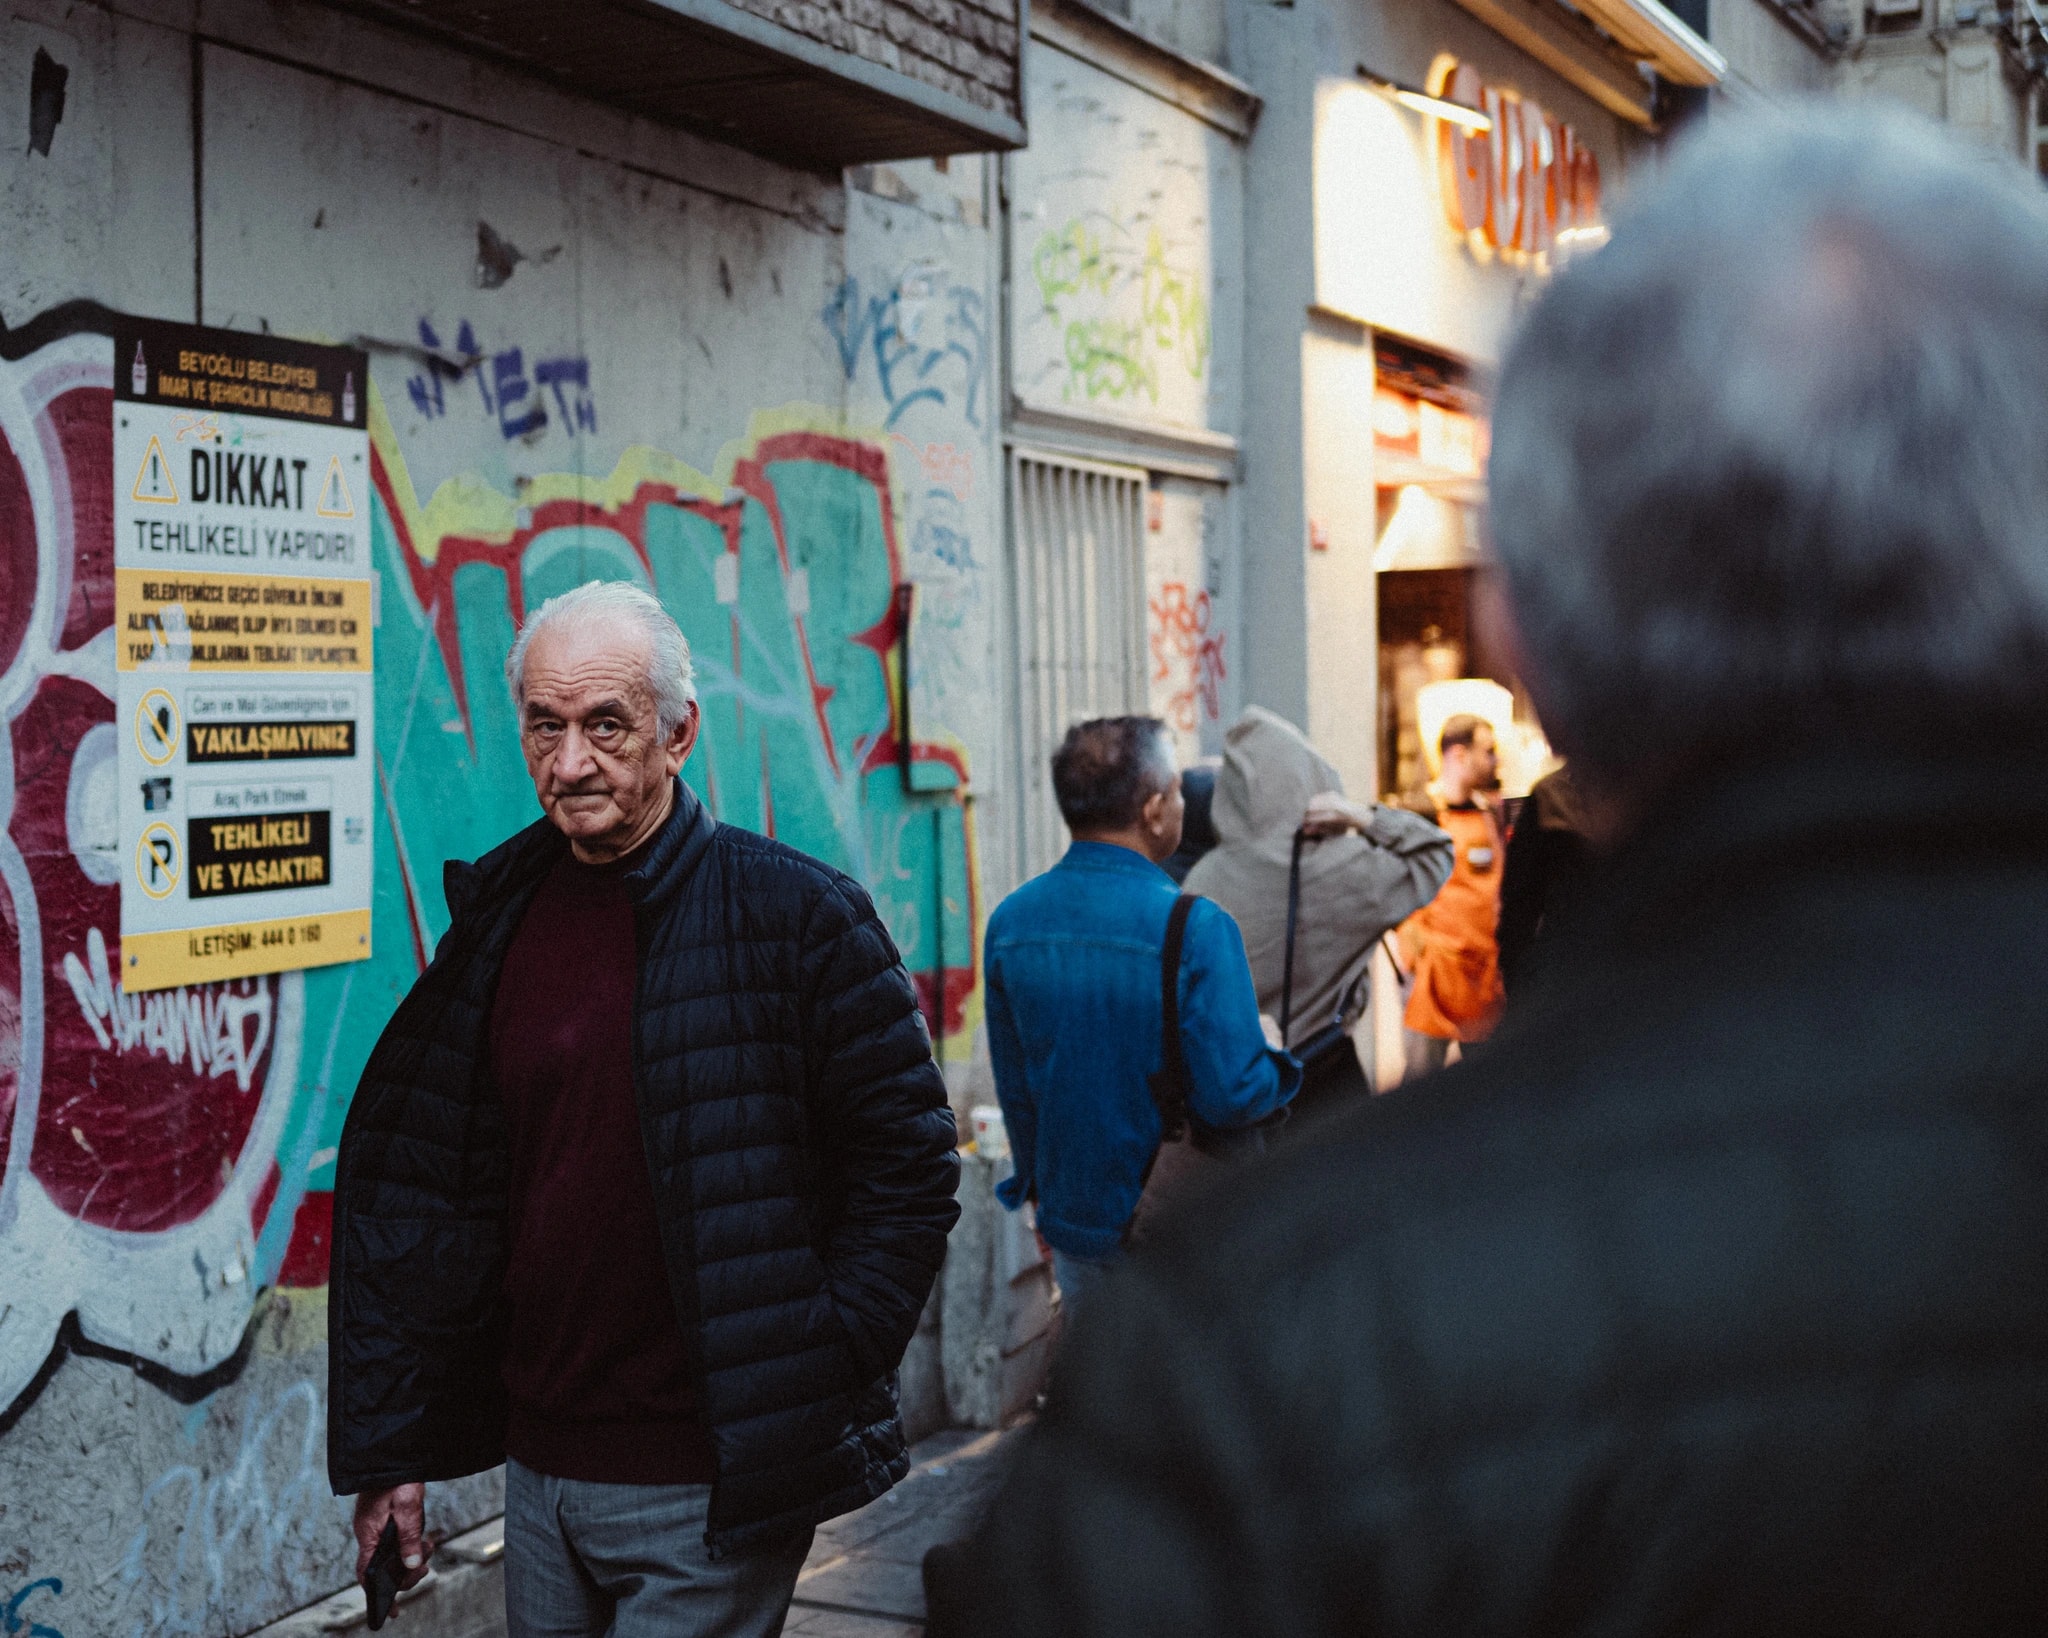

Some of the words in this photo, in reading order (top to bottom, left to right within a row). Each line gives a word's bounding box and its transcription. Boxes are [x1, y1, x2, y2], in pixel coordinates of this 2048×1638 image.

[179, 350, 245, 380] BEYOĞLU
[192, 379, 206, 401] VE
[190, 435, 308, 510] DİKKAT
[134, 513, 258, 557] TEHLİKELİ
[192, 725, 350, 759] YAKLAŞMAYINIZ
[211, 813, 311, 851] TEHLİKELİ
[196, 863, 224, 891] VE
[230, 855, 324, 888] YASAKTIR
[262, 929, 283, 947] 444
